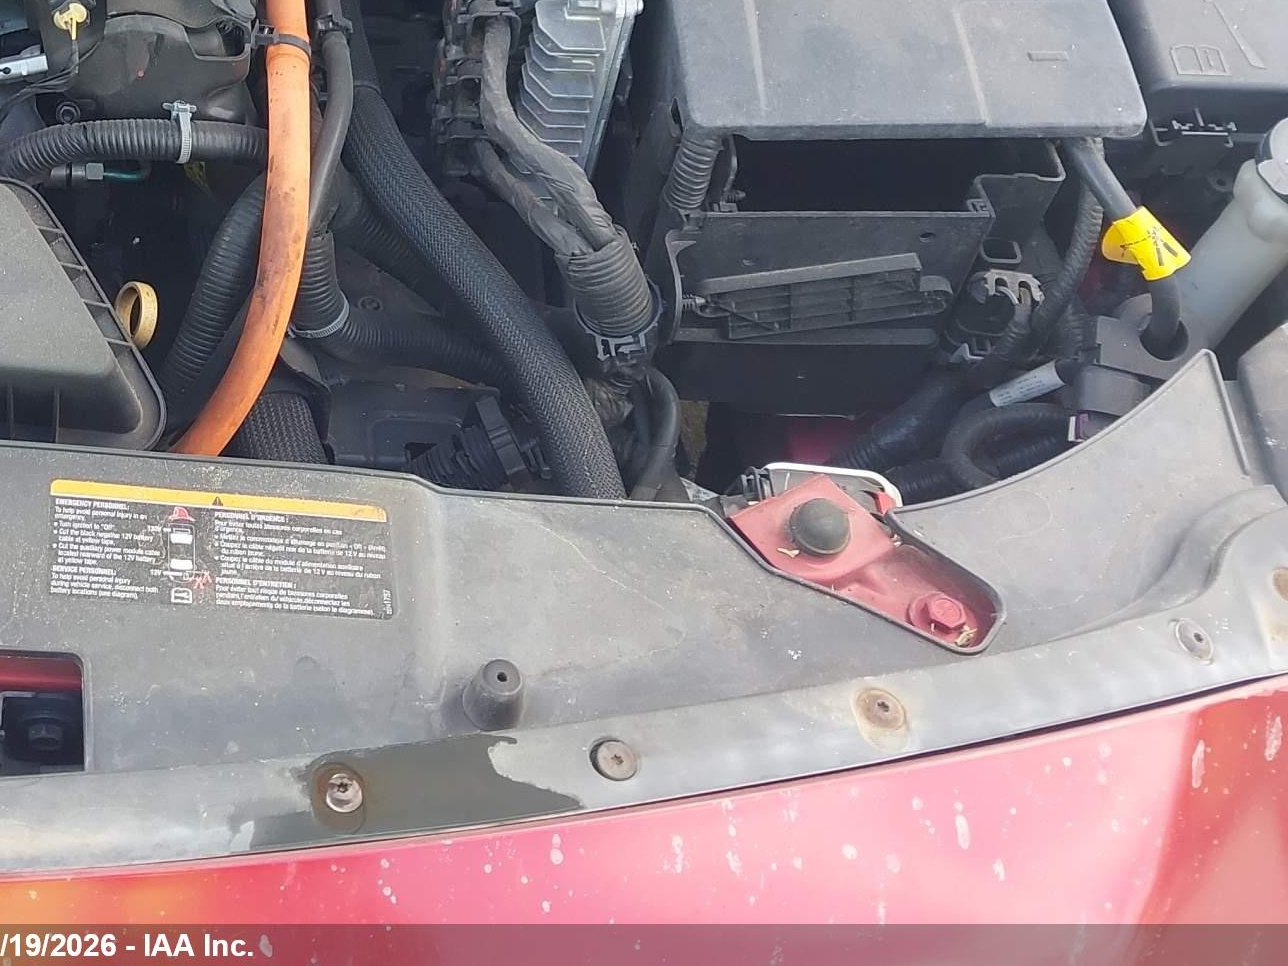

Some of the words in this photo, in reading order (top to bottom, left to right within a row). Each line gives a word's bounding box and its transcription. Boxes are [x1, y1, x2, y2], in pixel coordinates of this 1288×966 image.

[55, 498, 91, 507] EMERGENCY
[133, 534, 154, 542] battery
[53, 565, 78, 573] SERVICE
